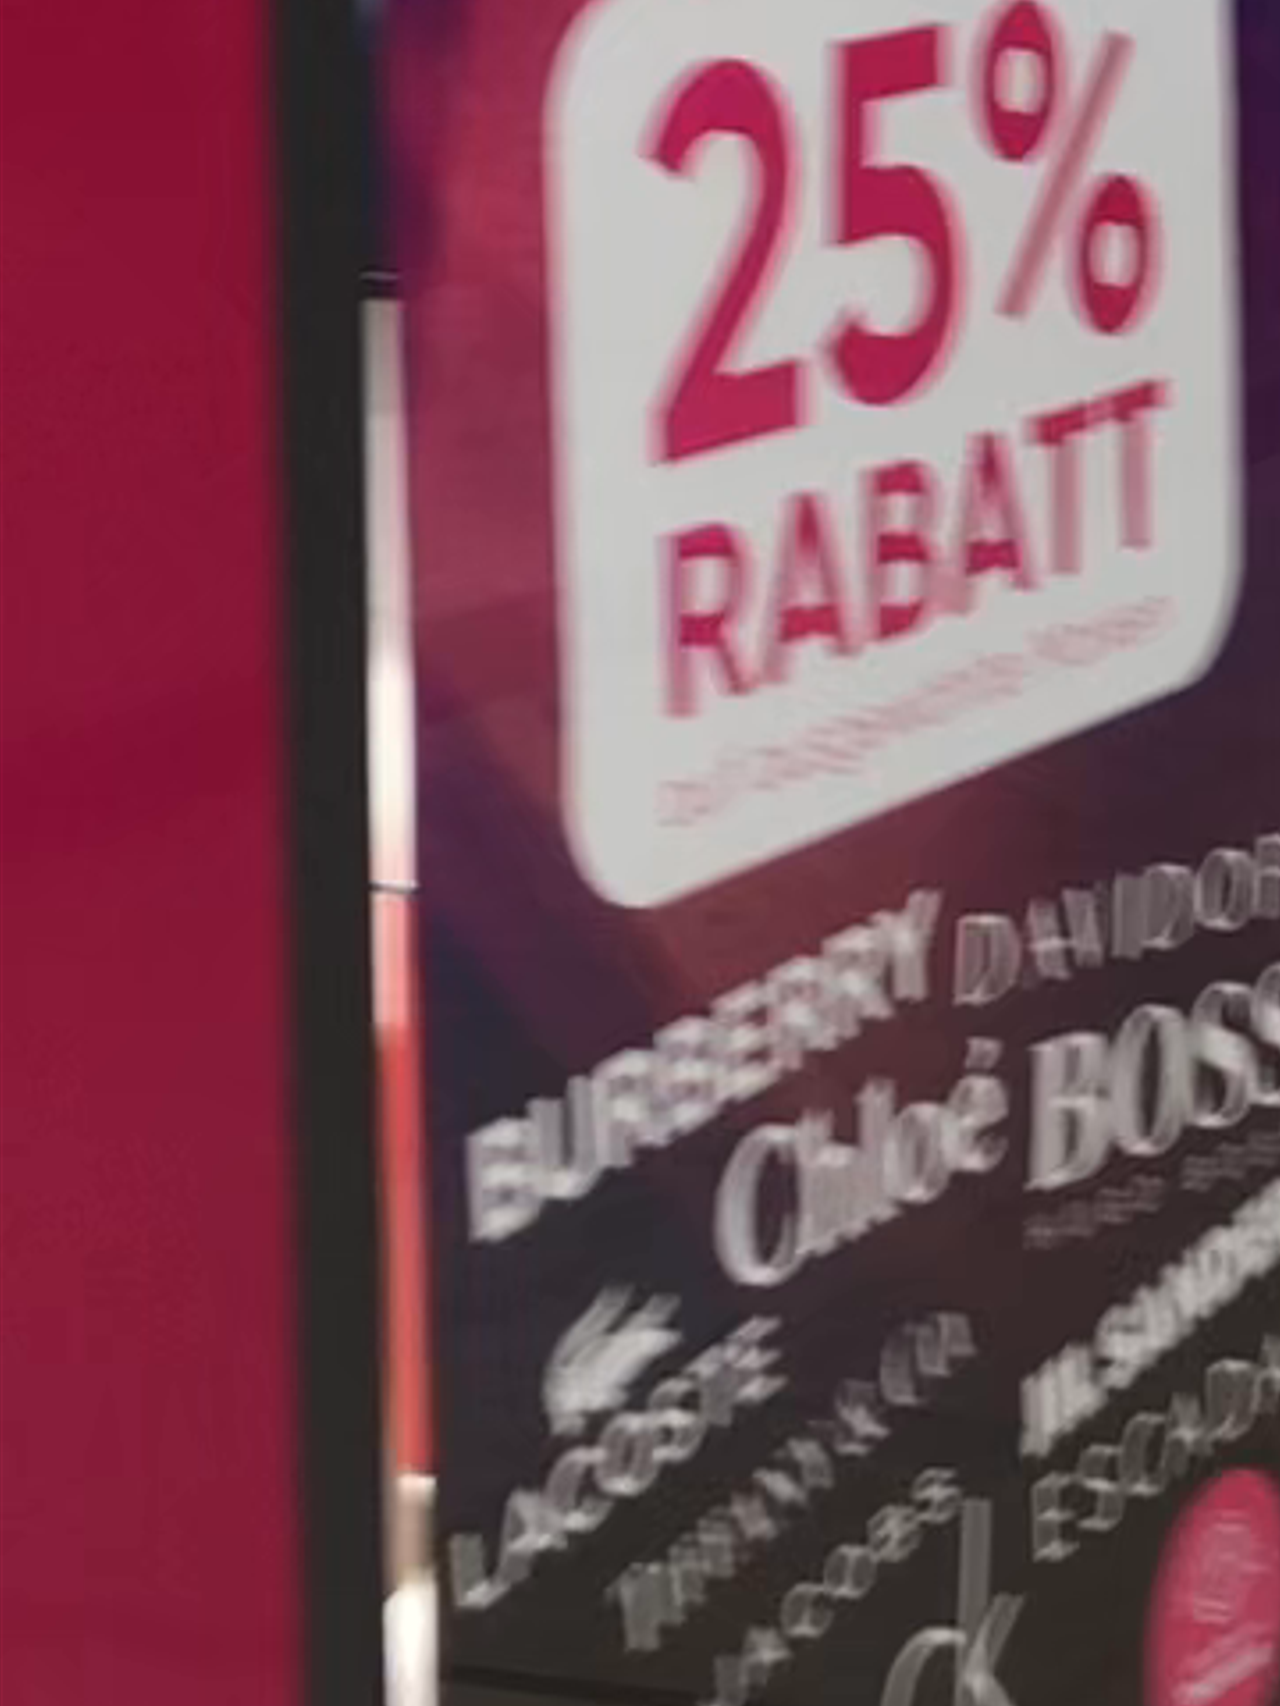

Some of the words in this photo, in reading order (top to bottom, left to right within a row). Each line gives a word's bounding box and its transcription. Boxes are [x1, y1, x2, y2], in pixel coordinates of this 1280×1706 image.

[657, 378, 1176, 718] RABATT
[465, 888, 942, 1243] BURBERRY
[713, 1036, 1010, 1288] Chloé
[448, 1314, 788, 1610] LACOSTE
